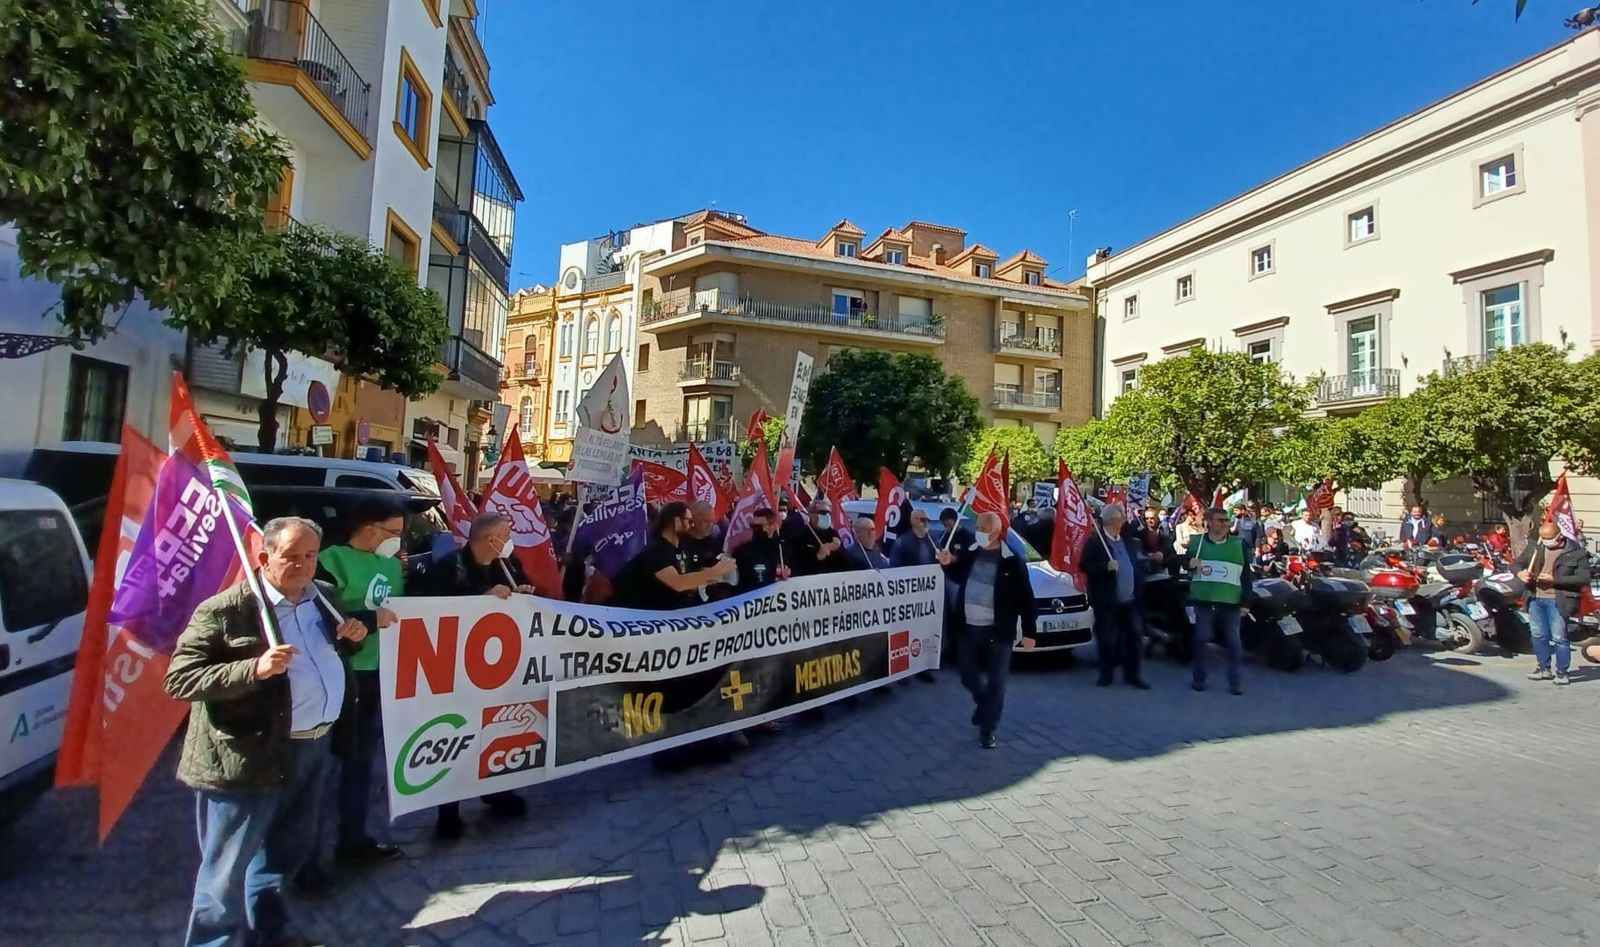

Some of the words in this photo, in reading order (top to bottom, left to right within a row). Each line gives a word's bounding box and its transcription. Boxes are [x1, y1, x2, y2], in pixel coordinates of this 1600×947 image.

[522, 656, 554, 685] AL
[560, 646, 681, 679] TRASLADO
[686, 642, 711, 666] DE
[713, 620, 811, 659] PRODUCCIÓN
[813, 619, 829, 637] DE
[832, 611, 880, 634] FÁBRICA
[883, 606, 897, 624] DE
[898, 600, 937, 621] SEVILLA
[528, 612, 544, 638] A
[552, 614, 604, 638] LOS
[607, 615, 716, 638] DESPIDOS
[716, 605, 740, 625] EN
[744, 592, 787, 621] GDELS
[791, 587, 832, 609] SANTA
[833, 580, 885, 603] BÁRBARA
[888, 575, 937, 597] SISTEMAS
[395, 611, 522, 700] NO
[623, 692, 664, 739] NO
[795, 649, 862, 693] MENTIRAS
[409, 734, 476, 769] CSIF
[488, 743, 543, 773] CGT
